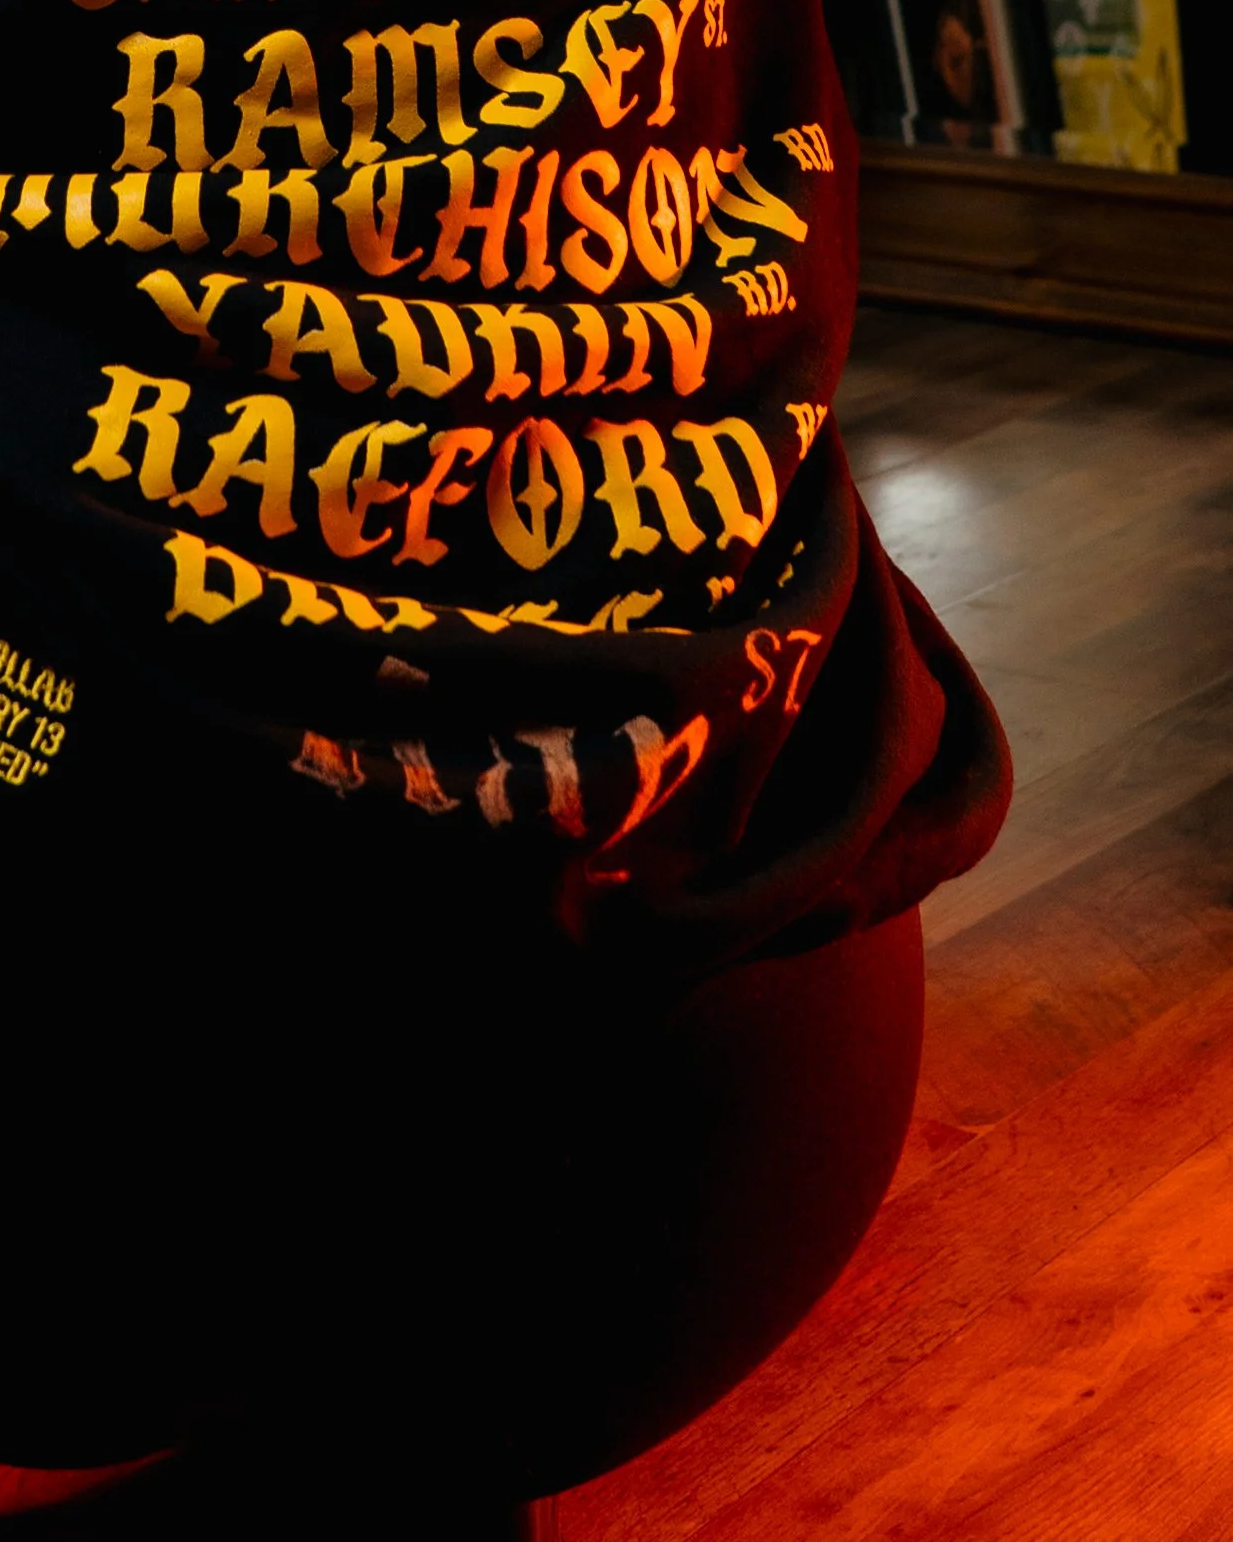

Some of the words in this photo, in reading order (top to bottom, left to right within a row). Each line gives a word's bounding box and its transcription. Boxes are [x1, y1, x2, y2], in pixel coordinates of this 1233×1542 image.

[137, 270, 712, 402] YADKIN
[722, 261, 797, 317] RD.
[73, 365, 778, 569] RAEFORD
[30, 717, 65, 756] 13
